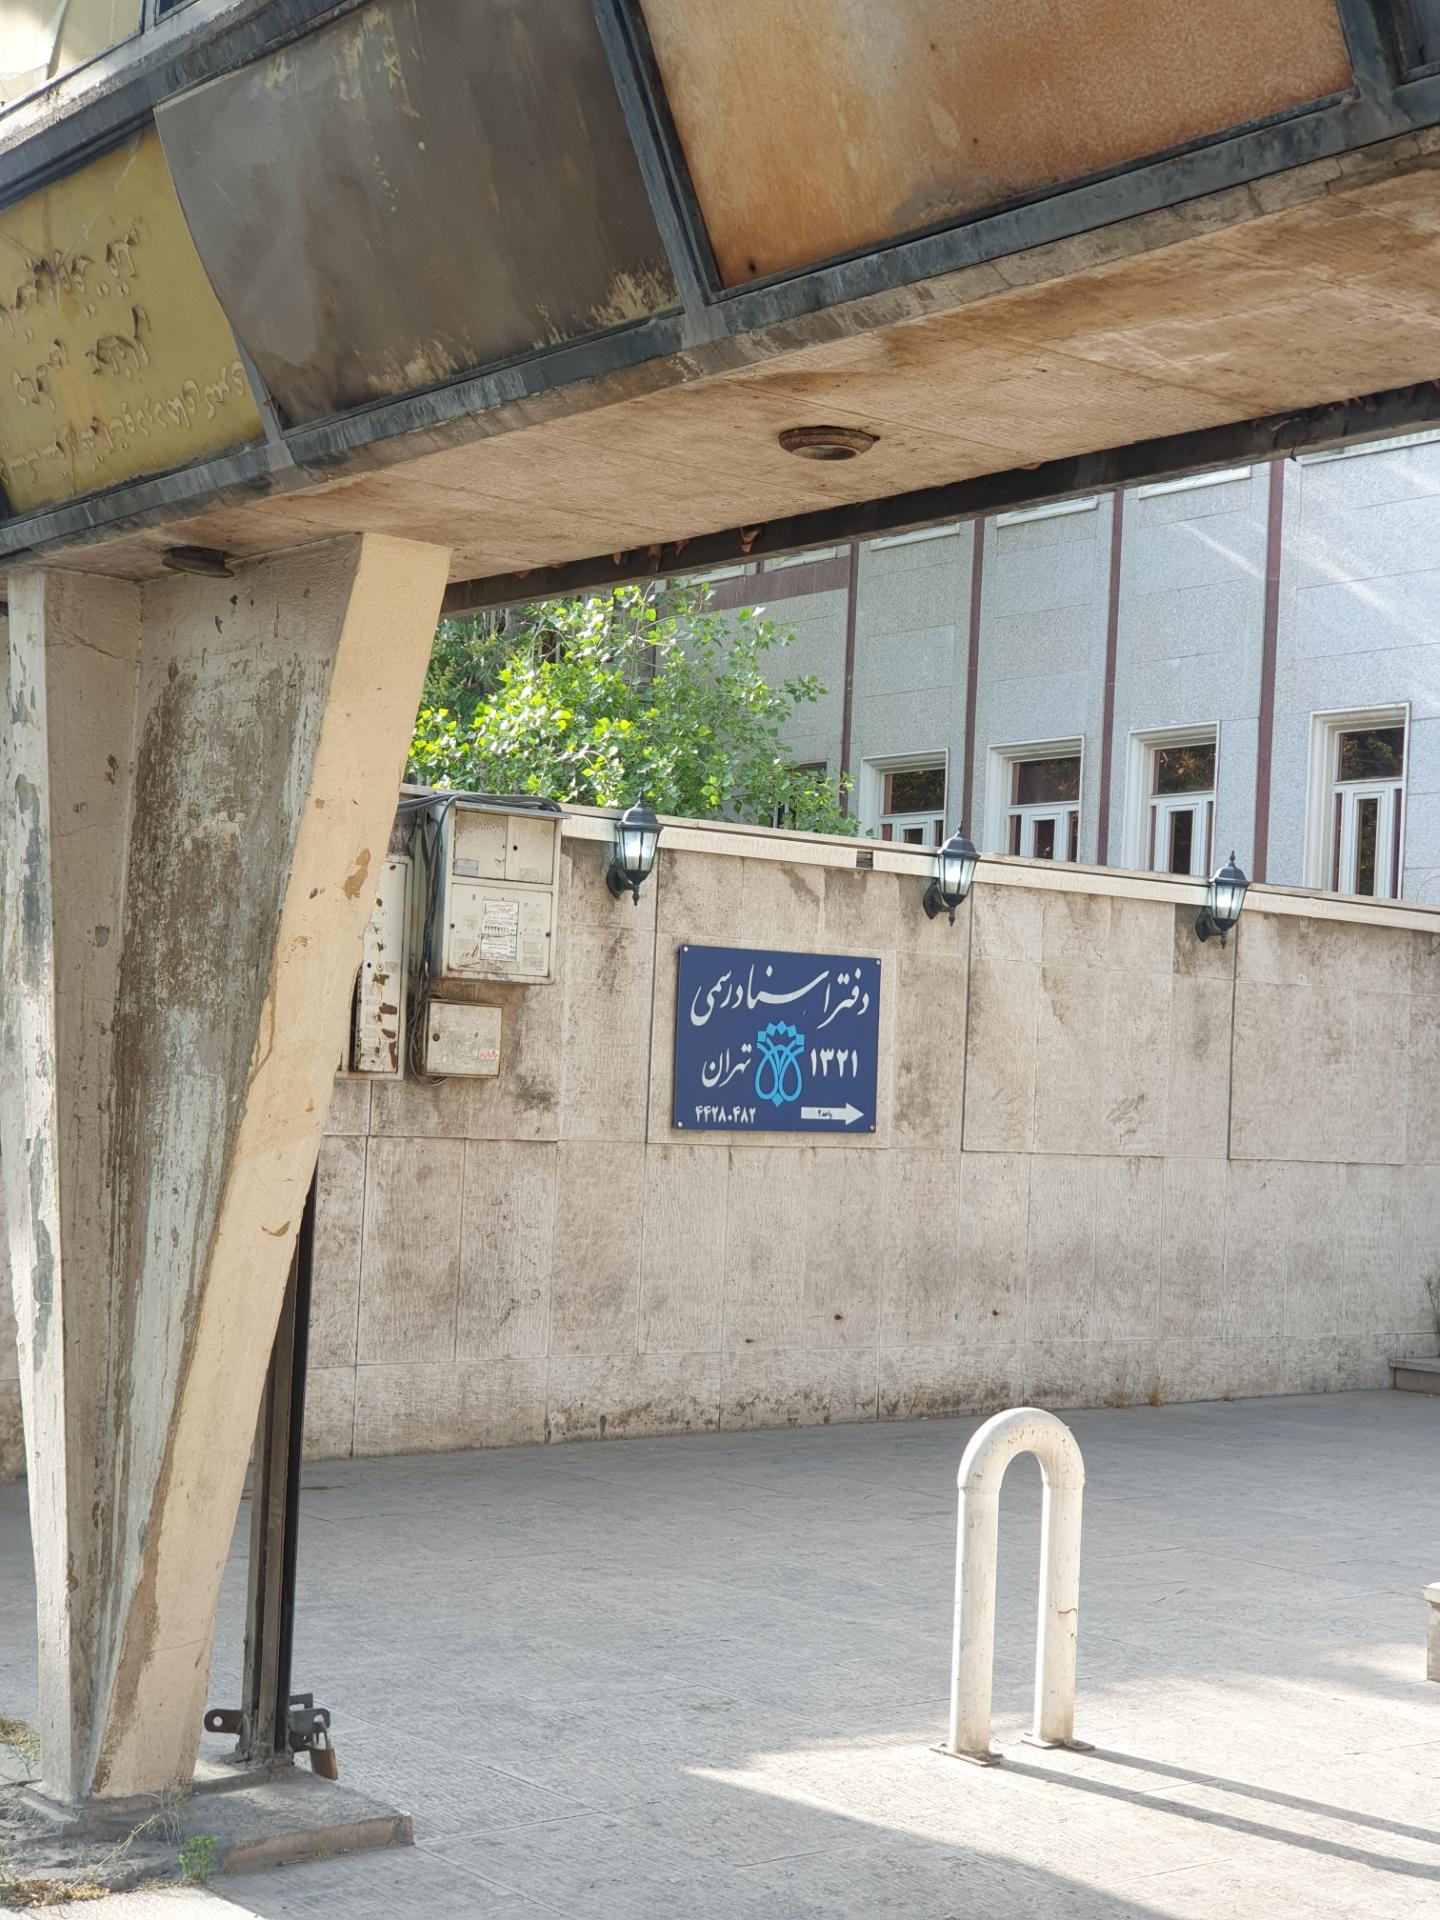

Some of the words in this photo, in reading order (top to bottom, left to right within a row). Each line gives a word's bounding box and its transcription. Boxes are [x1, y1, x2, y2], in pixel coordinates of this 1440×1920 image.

[690, 970, 733, 1027] رسمی
[731, 963, 831, 1013] اسناد
[817, 967, 870, 1029] دفتر
[701, 1043, 752, 1088] تهران
[810, 1047, 859, 1079] ۱۳۲۱
